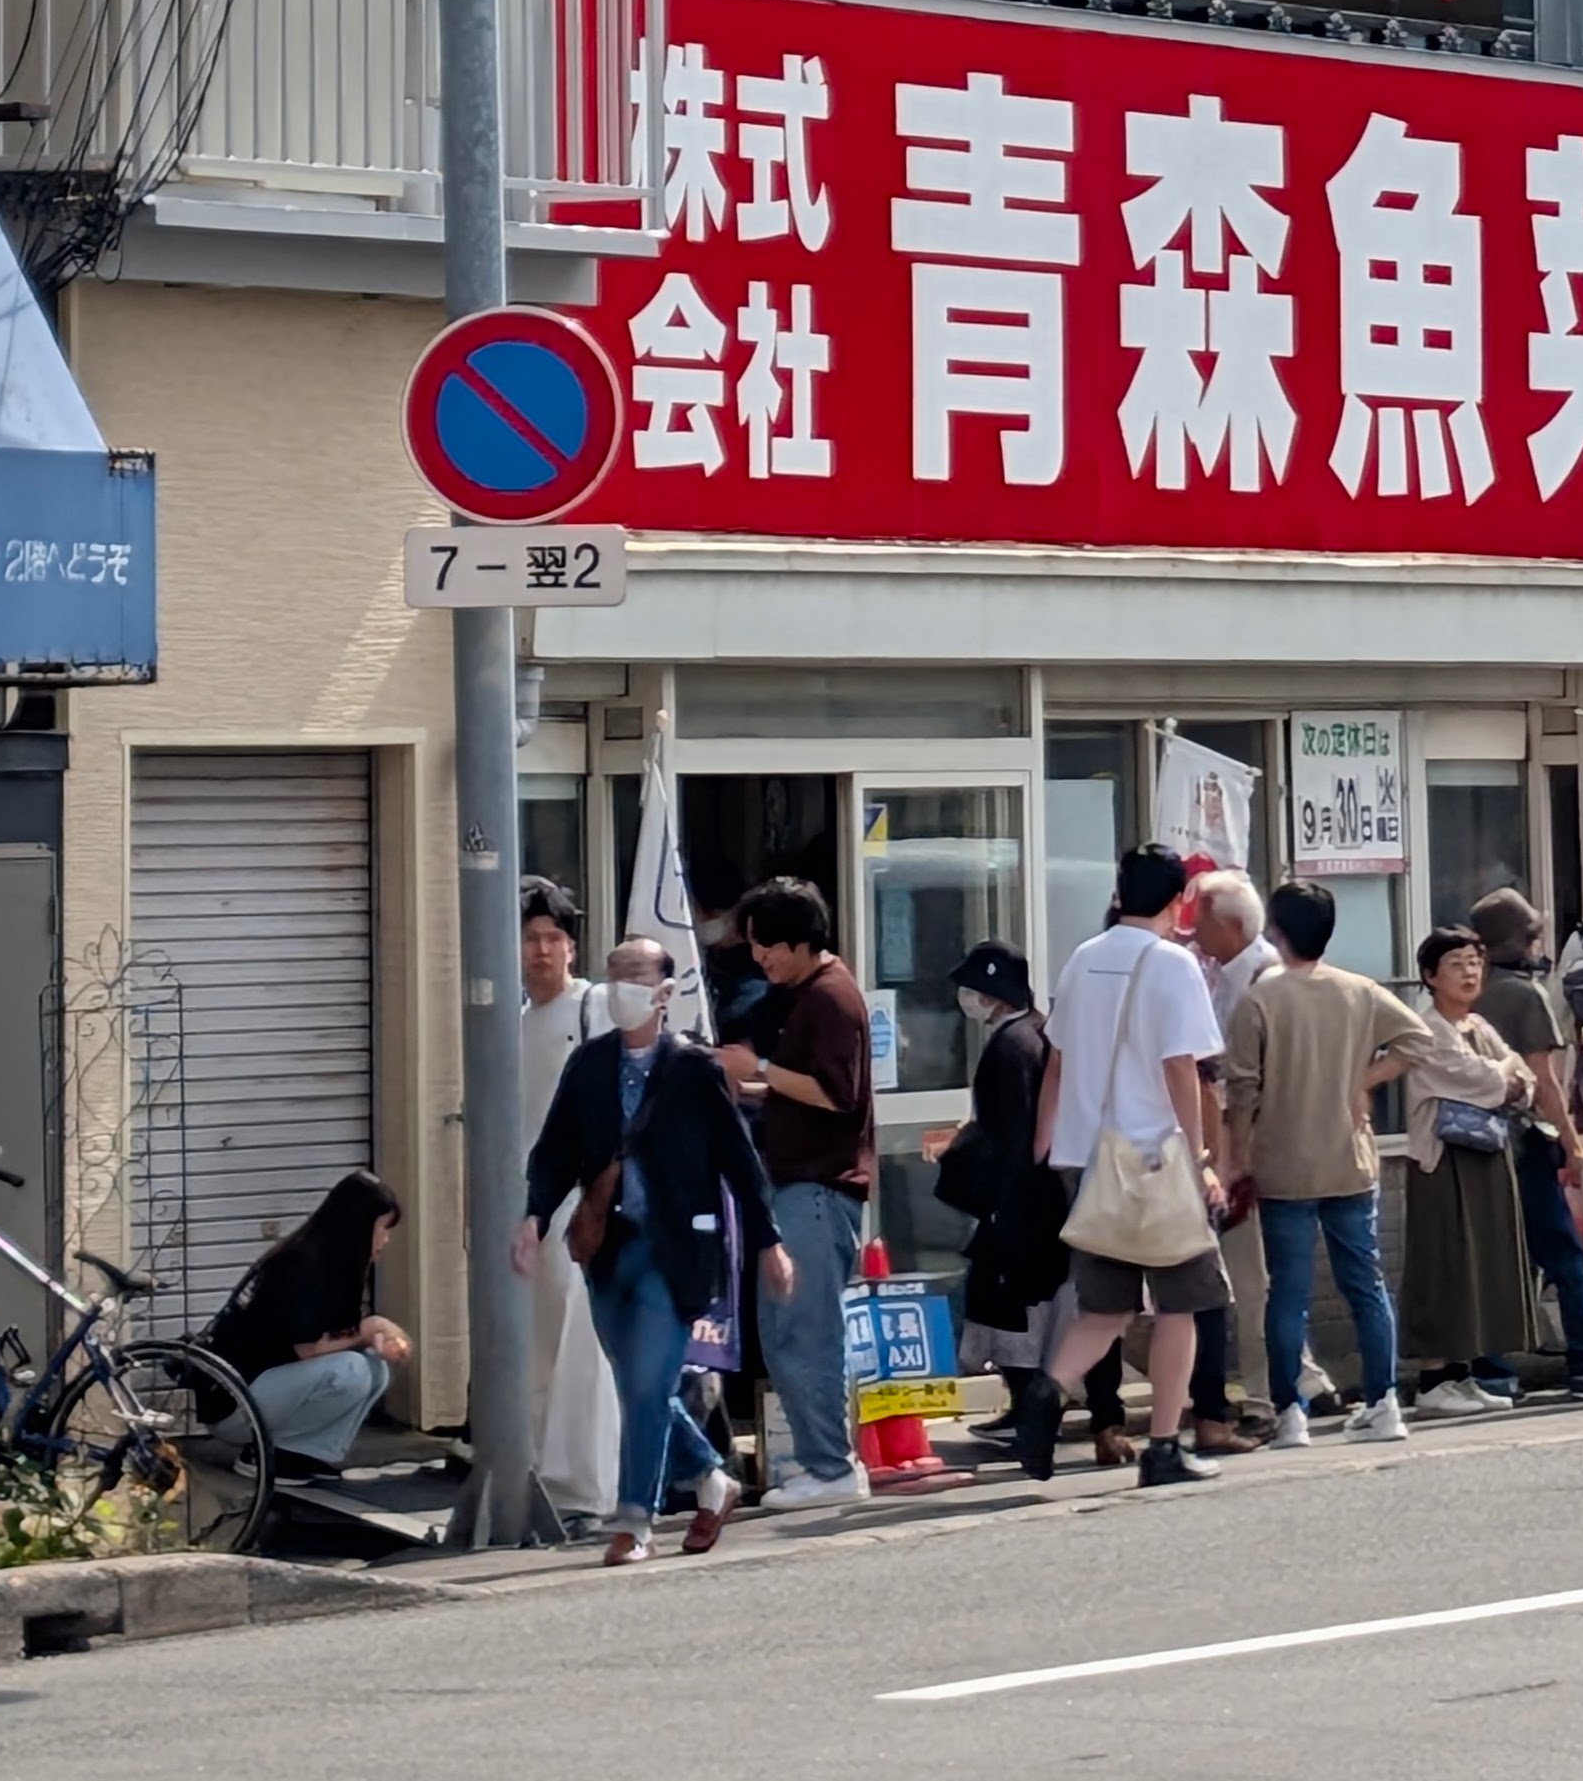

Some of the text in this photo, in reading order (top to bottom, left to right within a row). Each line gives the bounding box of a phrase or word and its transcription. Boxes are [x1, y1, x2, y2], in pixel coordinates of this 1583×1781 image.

[631, 42, 831, 253] 株式
[627, 272, 833, 480] 会社
[1301, 721, 1391, 757] 次の定休日は
